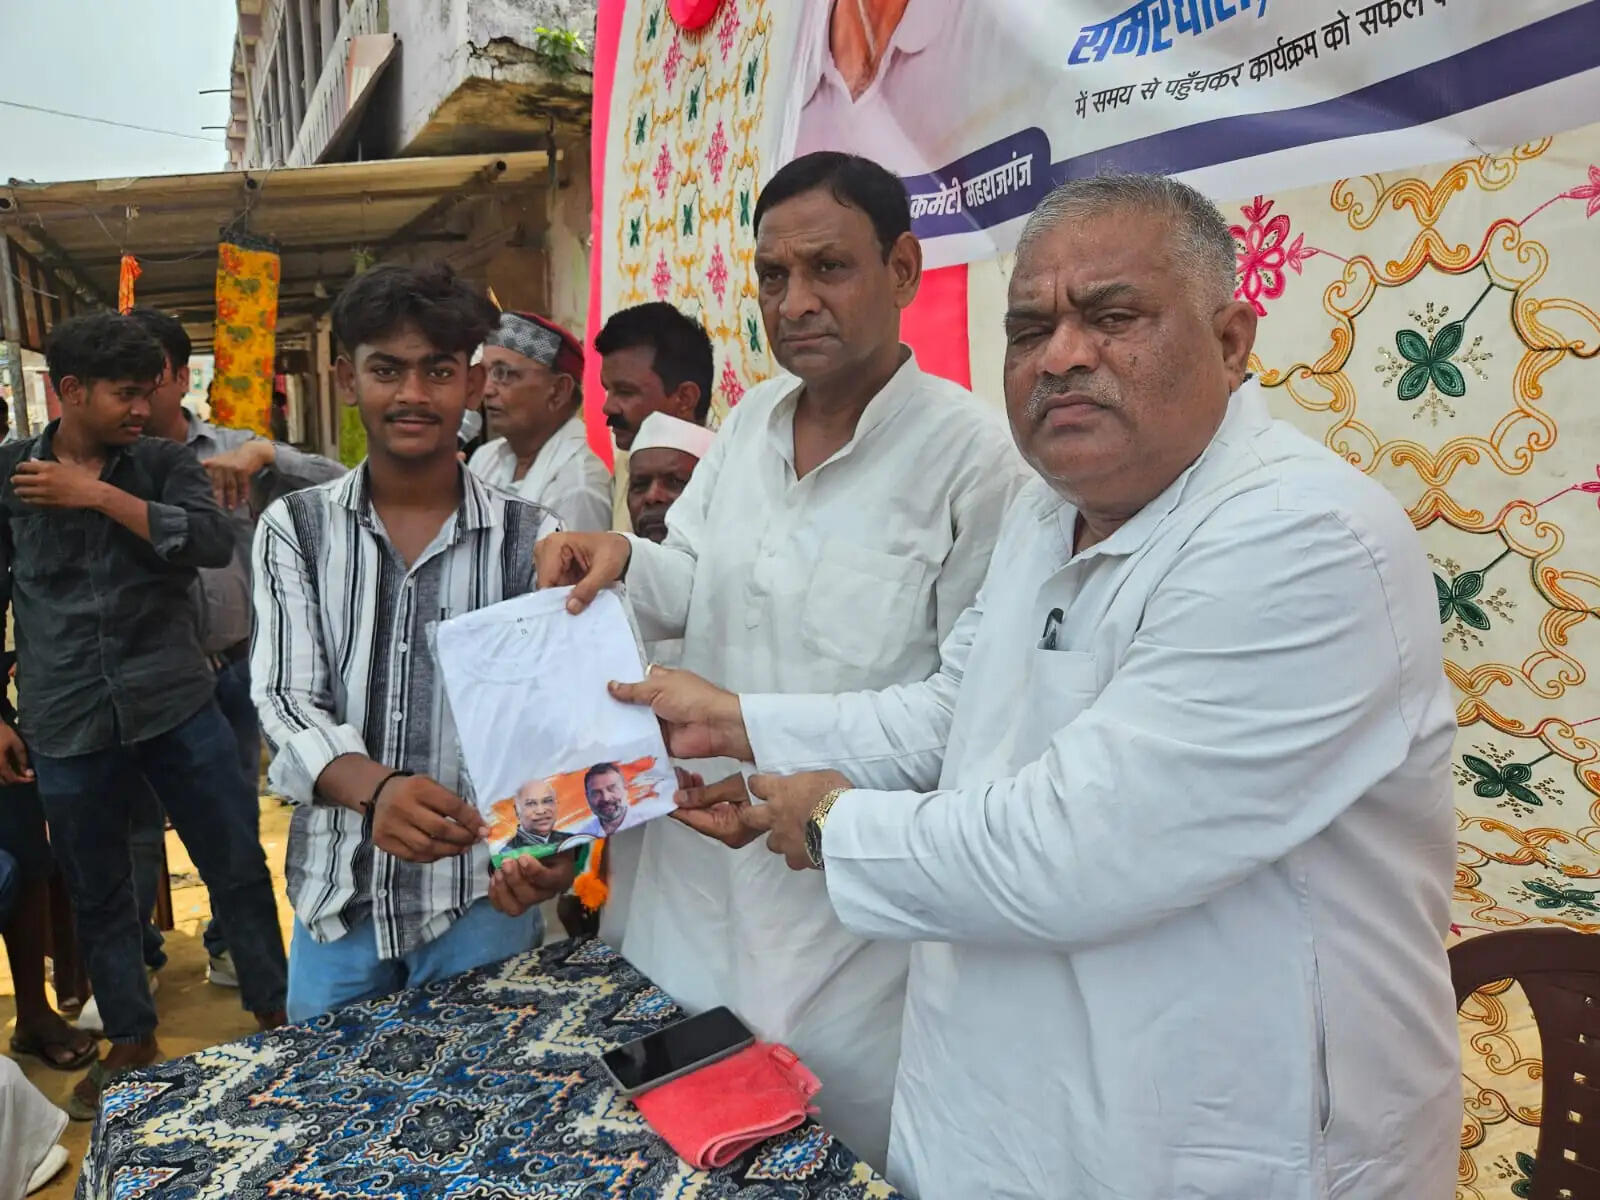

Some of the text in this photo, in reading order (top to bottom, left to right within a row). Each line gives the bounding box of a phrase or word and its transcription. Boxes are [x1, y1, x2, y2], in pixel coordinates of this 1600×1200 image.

[1075, 90, 1088, 119] में
[1092, 84, 1136, 113] समय
[1140, 77, 1161, 100] से
[1165, 62, 1245, 101] पहुँचकर
[1249, 30, 1319, 82] कार्यक्रम
[1321, 10, 1350, 50] को
[910, 151, 1034, 219] कमेटी महराजगंज
